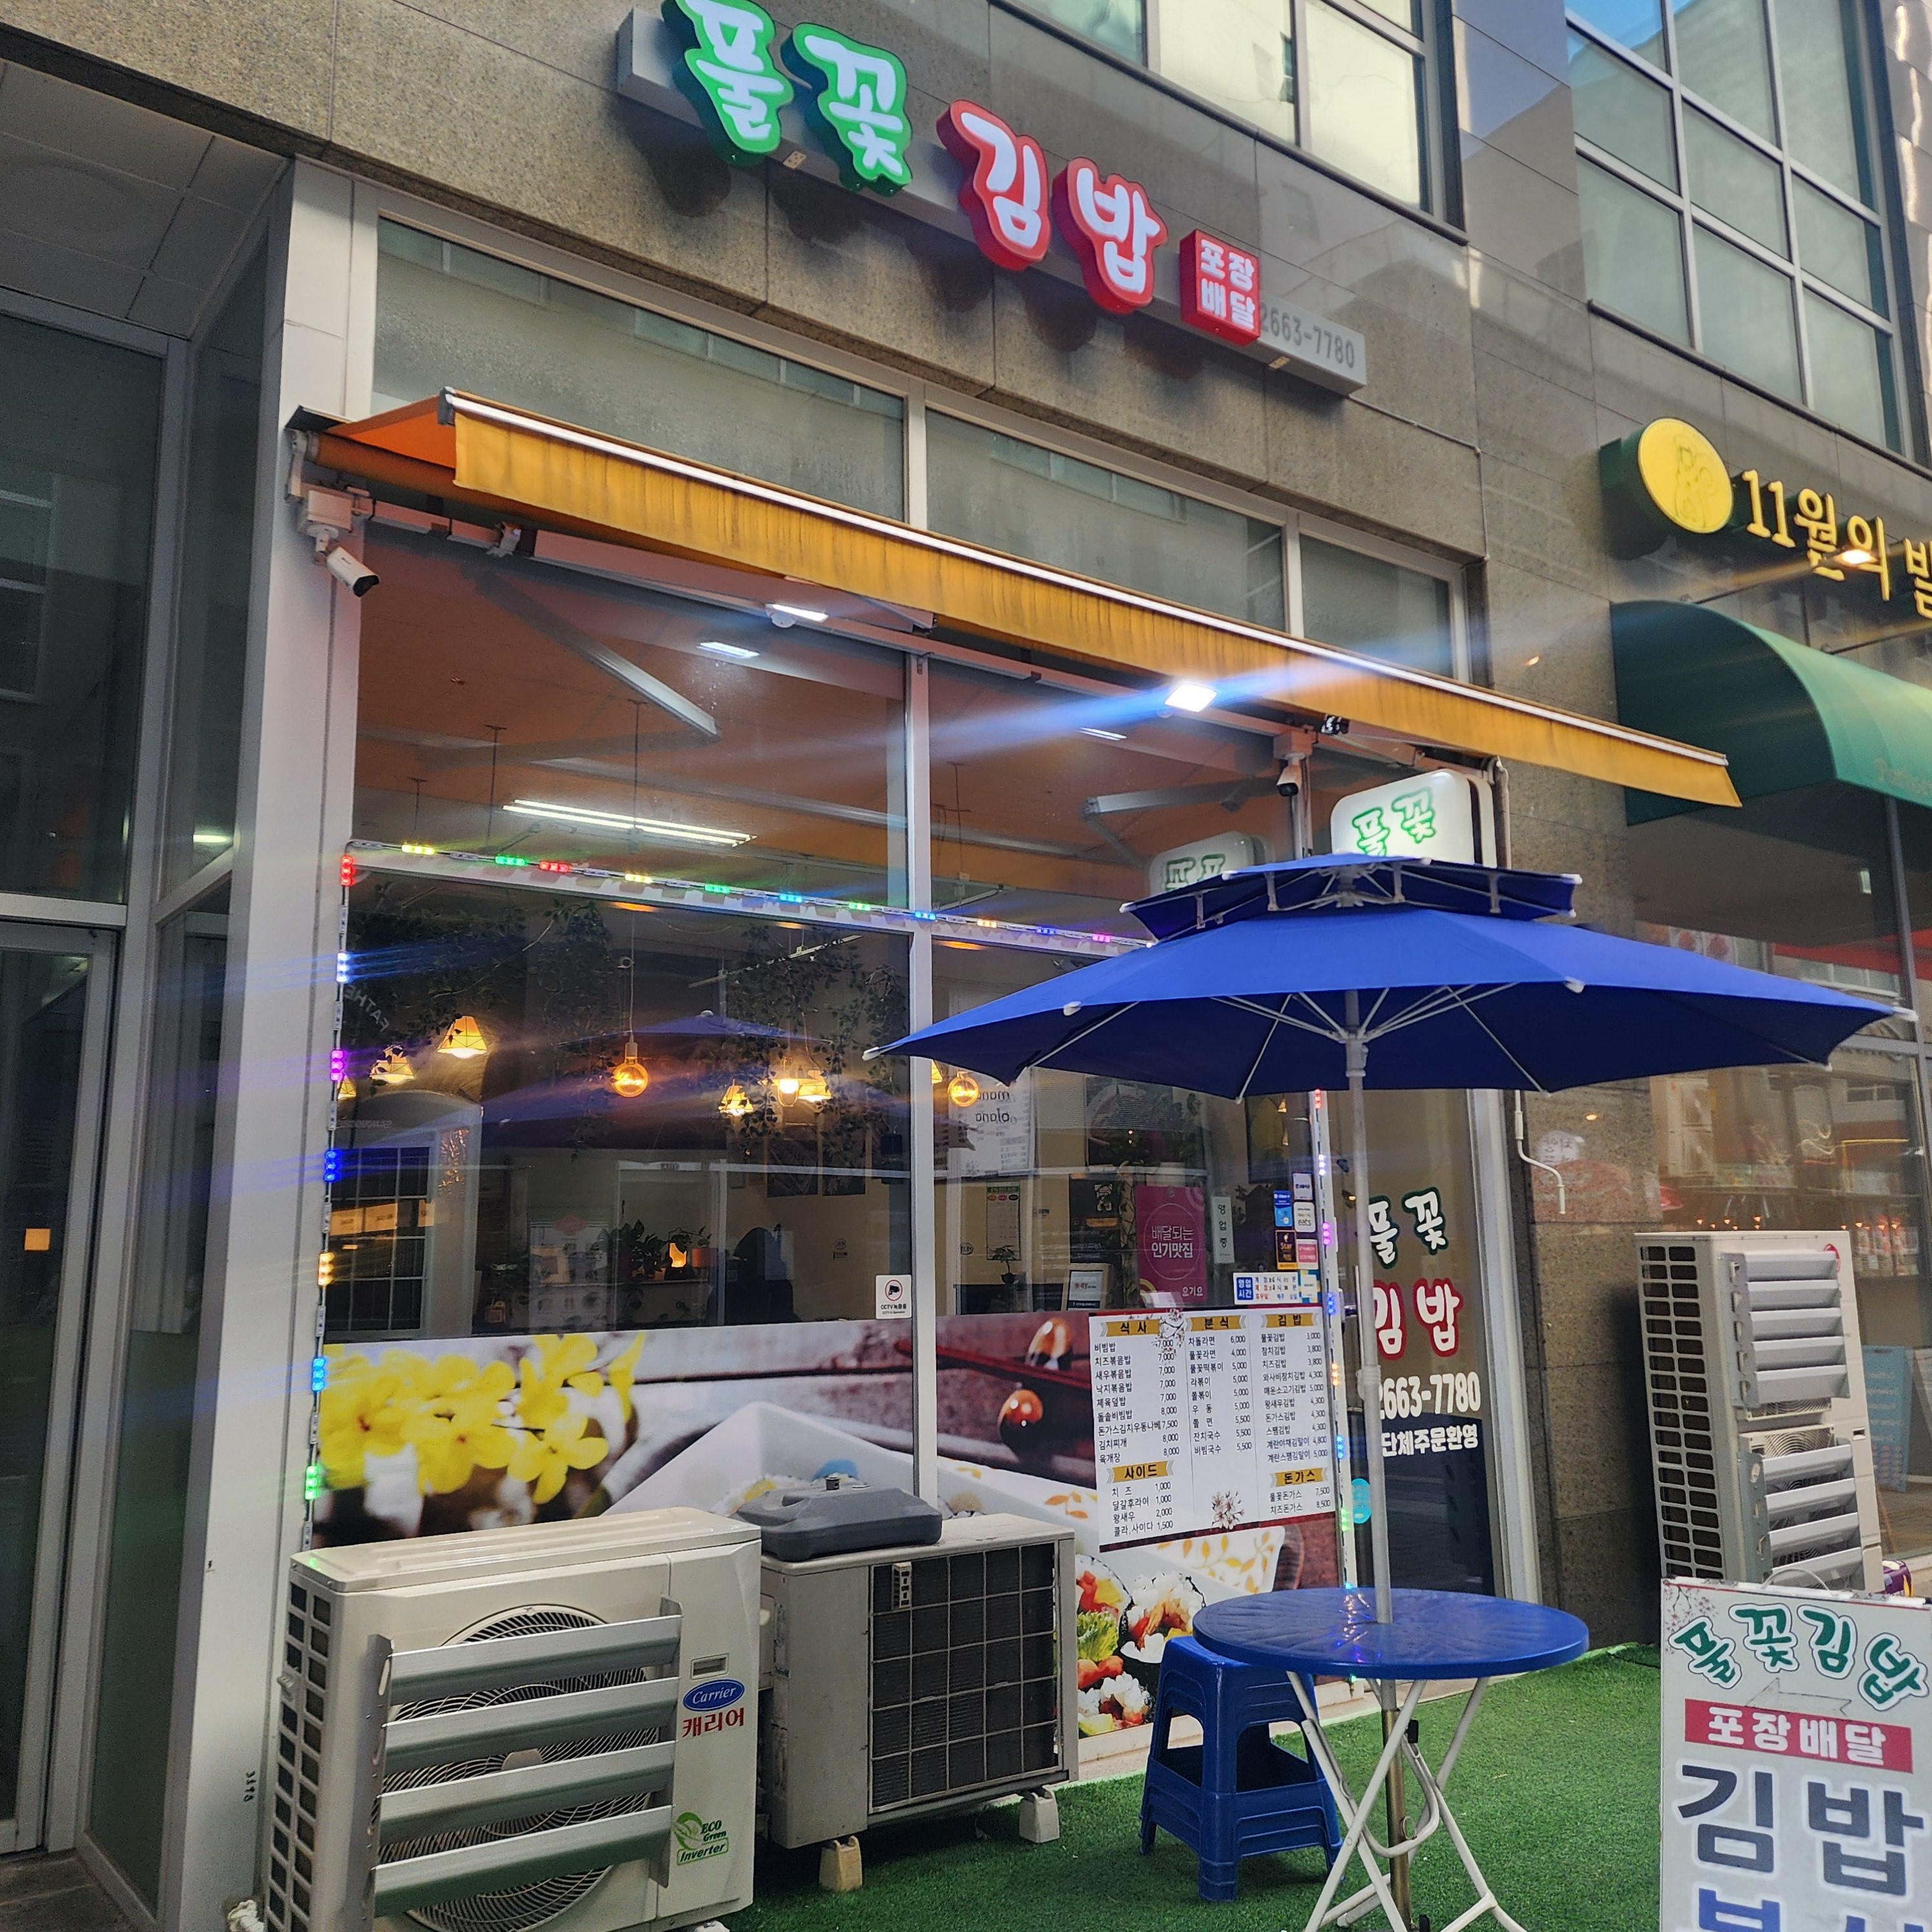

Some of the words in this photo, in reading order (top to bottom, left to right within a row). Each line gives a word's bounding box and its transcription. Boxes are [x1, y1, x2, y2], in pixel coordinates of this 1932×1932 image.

[683, 0, 905, 176] 풀꽃
[961, 112, 1161, 294] 김밥
[1200, 238, 1255, 293] 포장
[1200, 278, 1256, 331] 배달
[1742, 469, 1891, 601] 11월의
[1352, 787, 1436, 856] 풀꽃
[1151, 1225, 1195, 1242] 배달되는
[1368, 1191, 1446, 1264] 풀꽃
[1151, 1242, 1194, 1259] 인기맛집
[1238, 1279, 1252, 1288] 영업
[1238, 1289, 1252, 1299] 시간
[1373, 1284, 1460, 1354] 김밥
[1230, 1335, 1246, 1344] 6,000
[1261, 1332, 1286, 1343] 풀꽃김밥
[1306, 1331, 1321, 1341] 3,000
[1094, 1342, 1116, 1353] 비빔밥
[1158, 1339, 1174, 1348] 7,000
[1261, 1346, 1286, 1357] 참치김밥
[1307, 1344, 1322, 1354] 3,800
[1095, 1355, 1131, 1366] 치즈볶음밥
[1158, 1352, 1175, 1362] 7,000
[1189, 1349, 1216, 1361] 풀꽃라면
[1231, 1348, 1247, 1357] 4,000
[1190, 1362, 1224, 1374] 풀꽃떡볶이
[1232, 1361, 1248, 1371] 5,000
[1262, 1359, 1287, 1369] 치즈김밥
[1308, 1357, 1323, 1367] 3,800
[1096, 1368, 1132, 1381] 새우볶음밥
[1159, 1366, 1175, 1376] 7,000
[1263, 1371, 1306, 1382] 와사비참치김밥
[1308, 1370, 1324, 1380] 4,300
[1096, 1382, 1133, 1395] 낙지볶음밥
[1160, 1379, 1176, 1389] 7,000
[1191, 1376, 1211, 1388] 라볶이
[1233, 1375, 1248, 1384] 5,000
[1233, 1388, 1249, 1398] 5,000
[1264, 1384, 1306, 1395] 매운소고기김밥
[1310, 1383, 1324, 1393] 5,000
[1096, 1396, 1126, 1408] 제육덮밥
[1160, 1393, 1177, 1403] 7,000
[1234, 1401, 1250, 1412] 5,000
[1264, 1397, 1295, 1410] 왕새우김밥
[1310, 1396, 1325, 1405] 4,300
[1098, 1409, 1133, 1423] 돌솥비빔밥
[1161, 1406, 1177, 1416] 8,000
[1235, 1415, 1251, 1425] 5,500
[1266, 1411, 1296, 1423] 돈가스김밥
[1311, 1409, 1326, 1419] 4,300
[1098, 1421, 1161, 1437] 돈가스김치우동나베
[1162, 1419, 1178, 1430] 7,500
[1311, 1423, 1326, 1432] 4,300
[1162, 1433, 1179, 1443] 8,000
[1193, 1430, 1221, 1442] 잔치국수
[1236, 1428, 1251, 1438] 5,500
[1313, 1435, 1328, 1446] 4,800
[1100, 1452, 1120, 1464] 육개장
[1163, 1446, 1180, 1457] 8,000
[1194, 1444, 1222, 1455] 비빔국수
[1237, 1442, 1253, 1452] 5,500
[1313, 1449, 1328, 1459] 5,000
[1124, 1464, 1158, 1479] 사이드
[1284, 1470, 1315, 1485] 돈가스
[1155, 1481, 1171, 1492] 1,000
[1156, 1494, 1172, 1505] 1,000
[1269, 1490, 1302, 1503] 풀꽃돈가스
[1315, 1486, 1330, 1497] 7,500
[1270, 1503, 1302, 1516] 치즈돈가스
[1317, 1499, 1331, 1509] 8,500
[1113, 1511, 1135, 1525] 왕새우
[1156, 1507, 1173, 1518] 2,000
[1156, 1520, 1173, 1532] 1,500
[692, 1687, 737, 1705] Carrier
[682, 1707, 745, 1738] 캐리어
[700, 1820, 723, 1835] ECO
[703, 1830, 727, 1842] Green
[679, 1843, 726, 1864] Inverter
